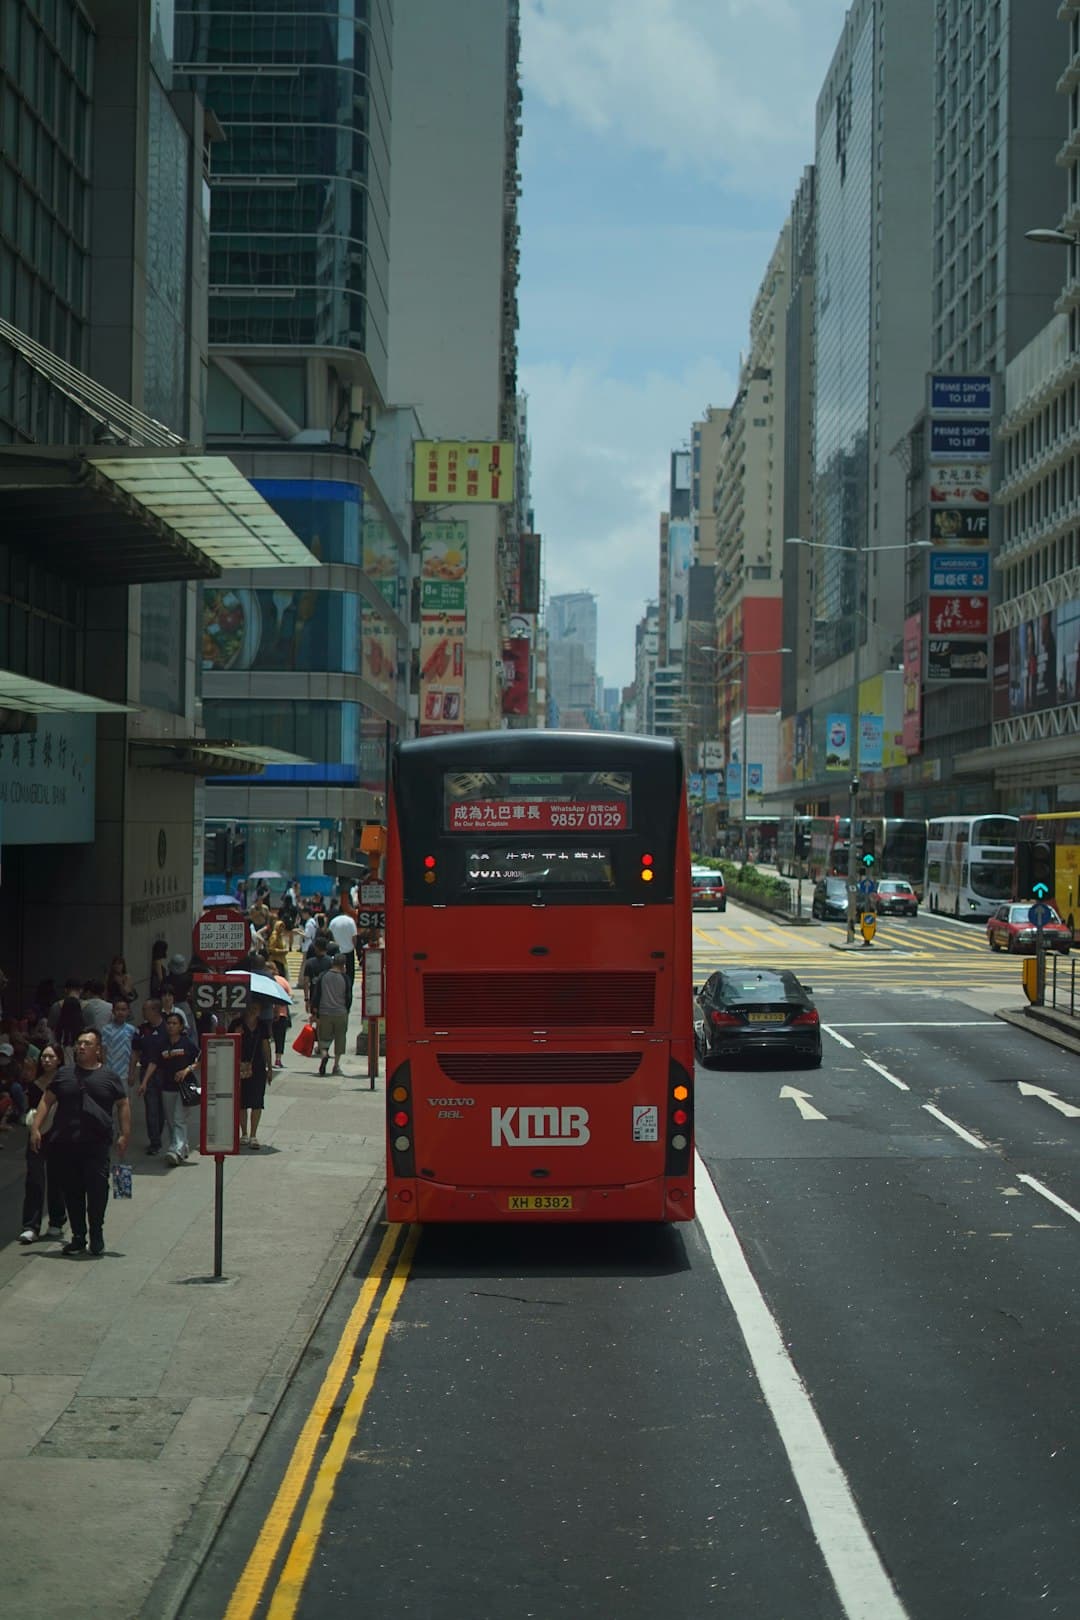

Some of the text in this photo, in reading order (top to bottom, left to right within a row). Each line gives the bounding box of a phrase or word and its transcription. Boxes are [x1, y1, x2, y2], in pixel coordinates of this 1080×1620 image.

[935, 383, 991, 392] PRIME SHOPS
[949, 394, 976, 402] TO LET
[934, 427, 960, 435] PRIME
[949, 438, 976, 446] TO LET
[966, 517, 987, 531] 1/F
[454, 805, 541, 820] 成為九巴車長
[551, 805, 585, 813] WhatsApp
[551, 813, 622, 826] 9857 0129
[197, 985, 247, 1008] S12
[428, 1097, 475, 1106] VOLVO
[491, 1106, 591, 1147] KMB
[512, 1198, 570, 1208] XH 8382
